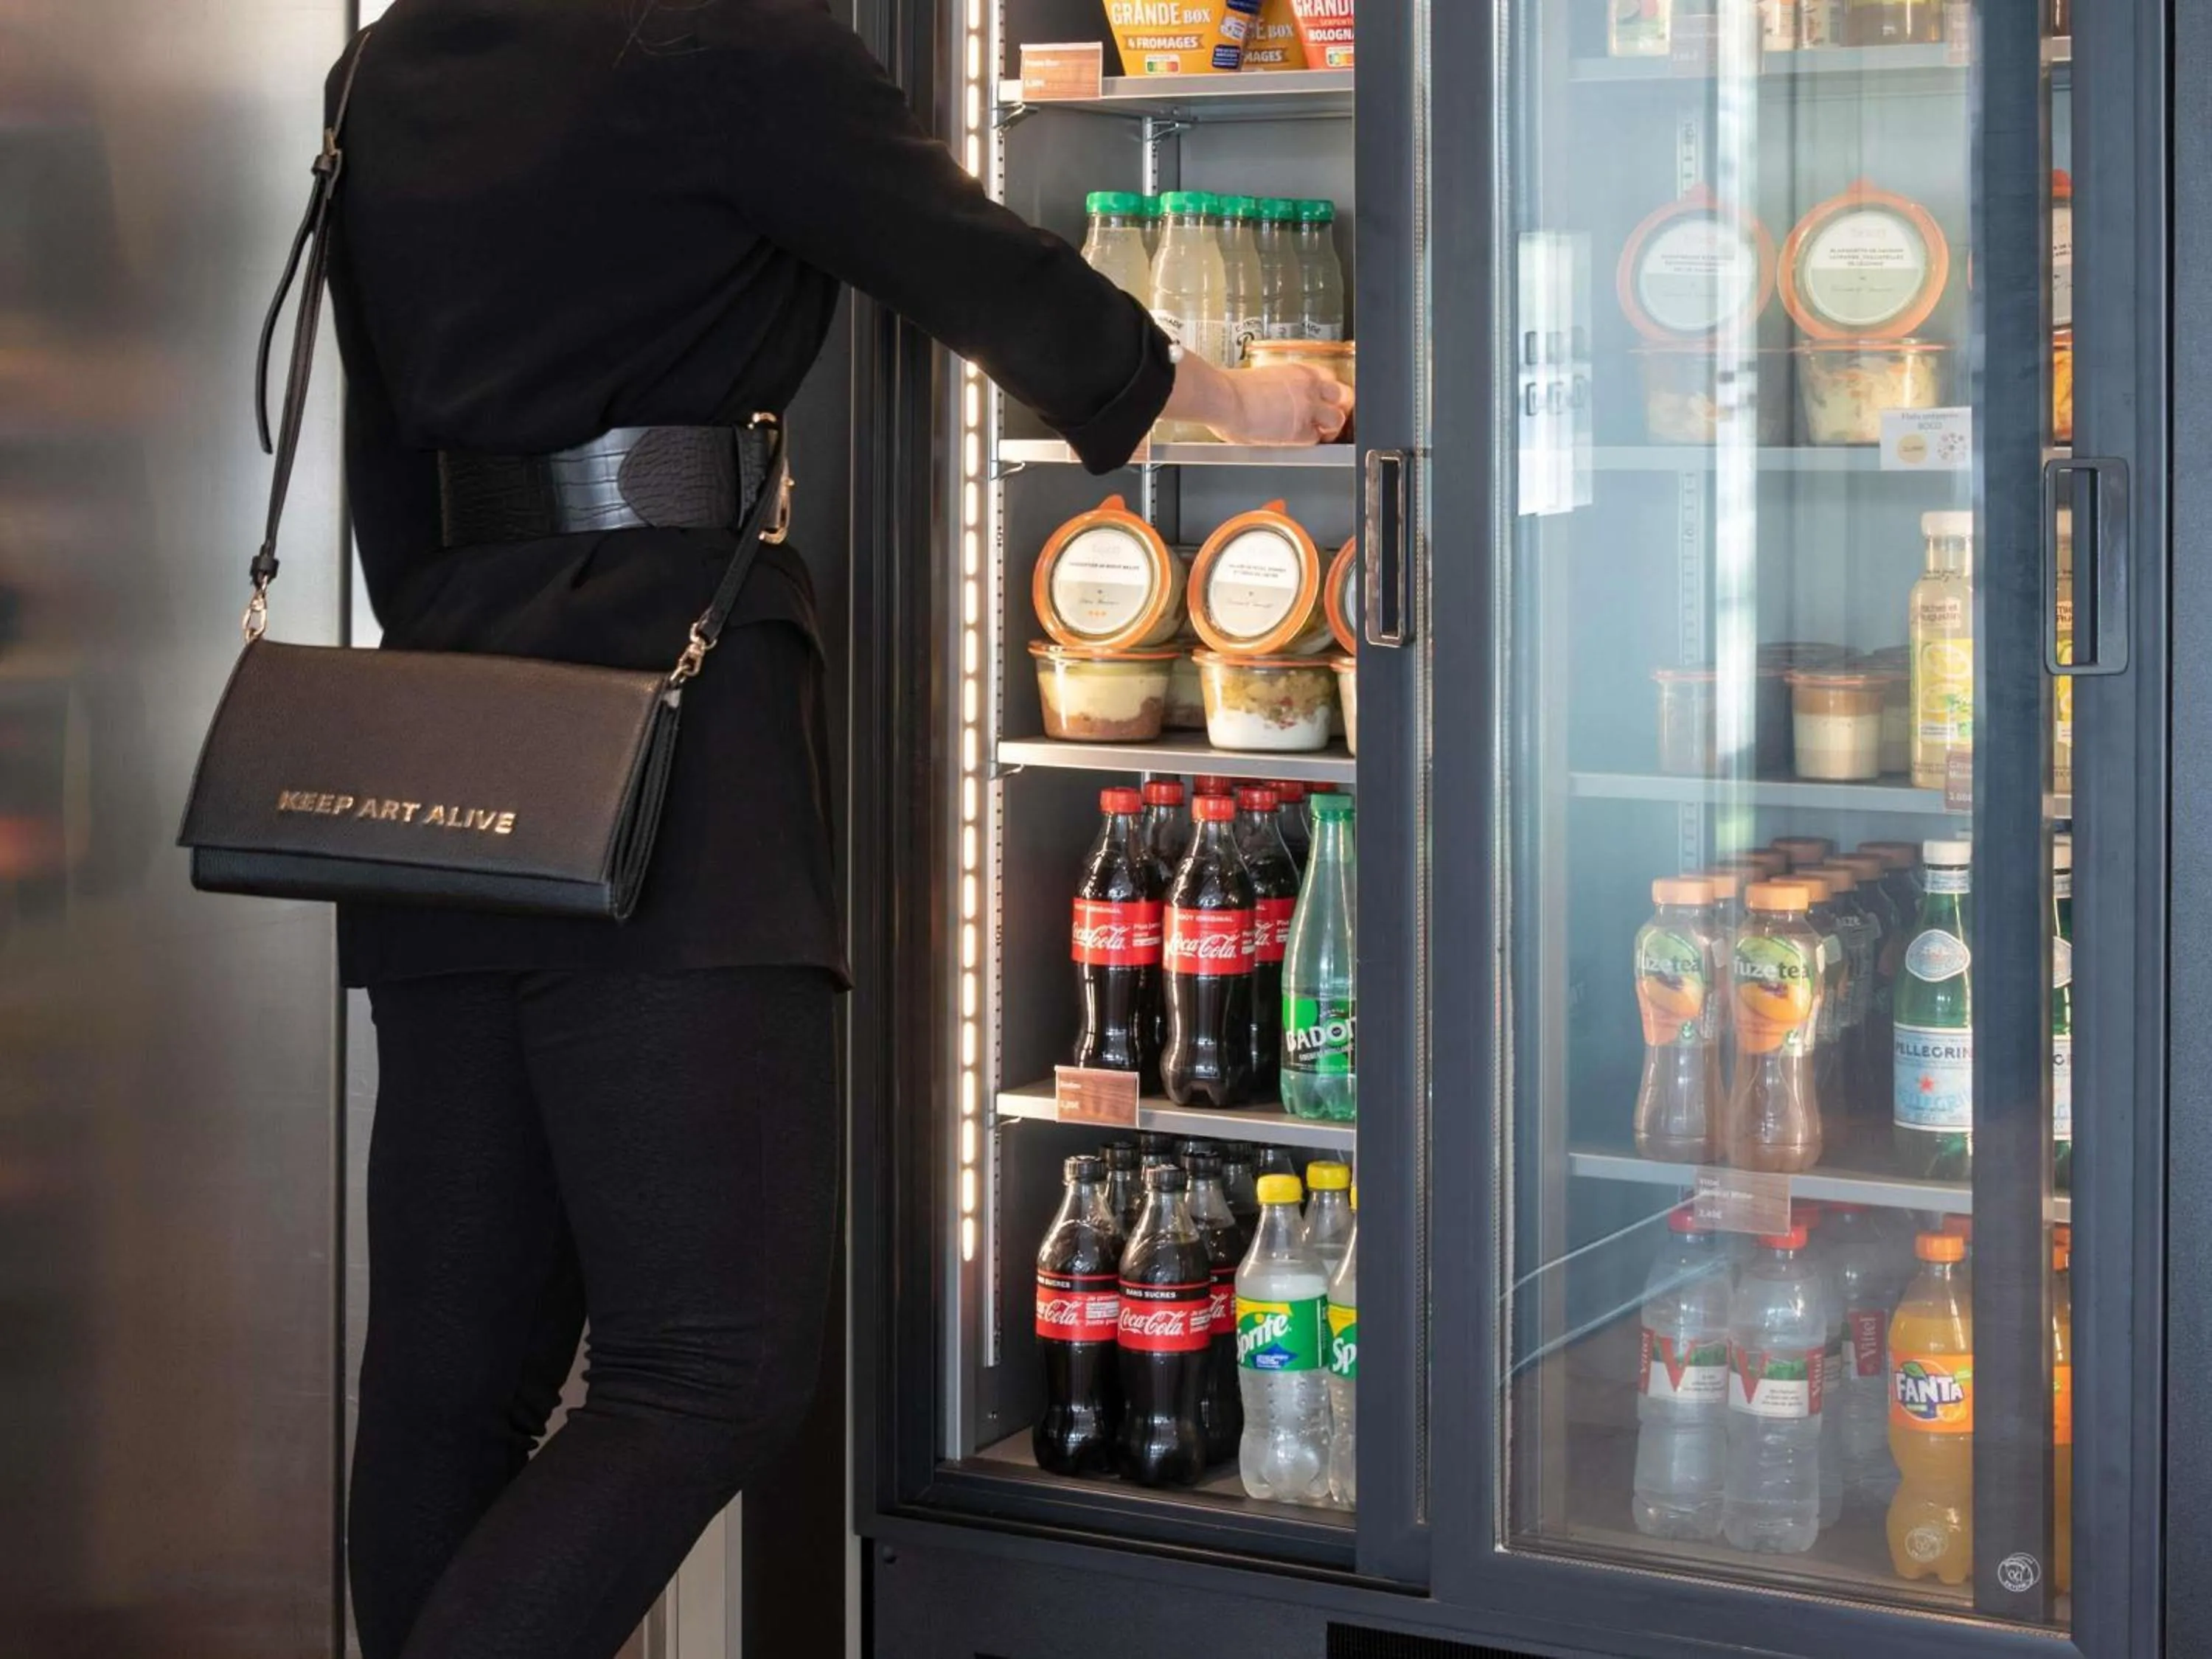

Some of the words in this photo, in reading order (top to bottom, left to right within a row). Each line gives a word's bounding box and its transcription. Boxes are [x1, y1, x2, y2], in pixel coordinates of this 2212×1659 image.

[1112, 1, 1180, 25] GRANDE
[1183, 9, 1211, 24] BOX
[1295, 0, 1354, 17] GRAND
[1136, 37, 1199, 49] FROMAGES
[277, 790, 355, 815] KEEP
[357, 798, 421, 823] ART
[422, 804, 516, 835] ALIVE
[1895, 1371, 1964, 1403] FANTA
